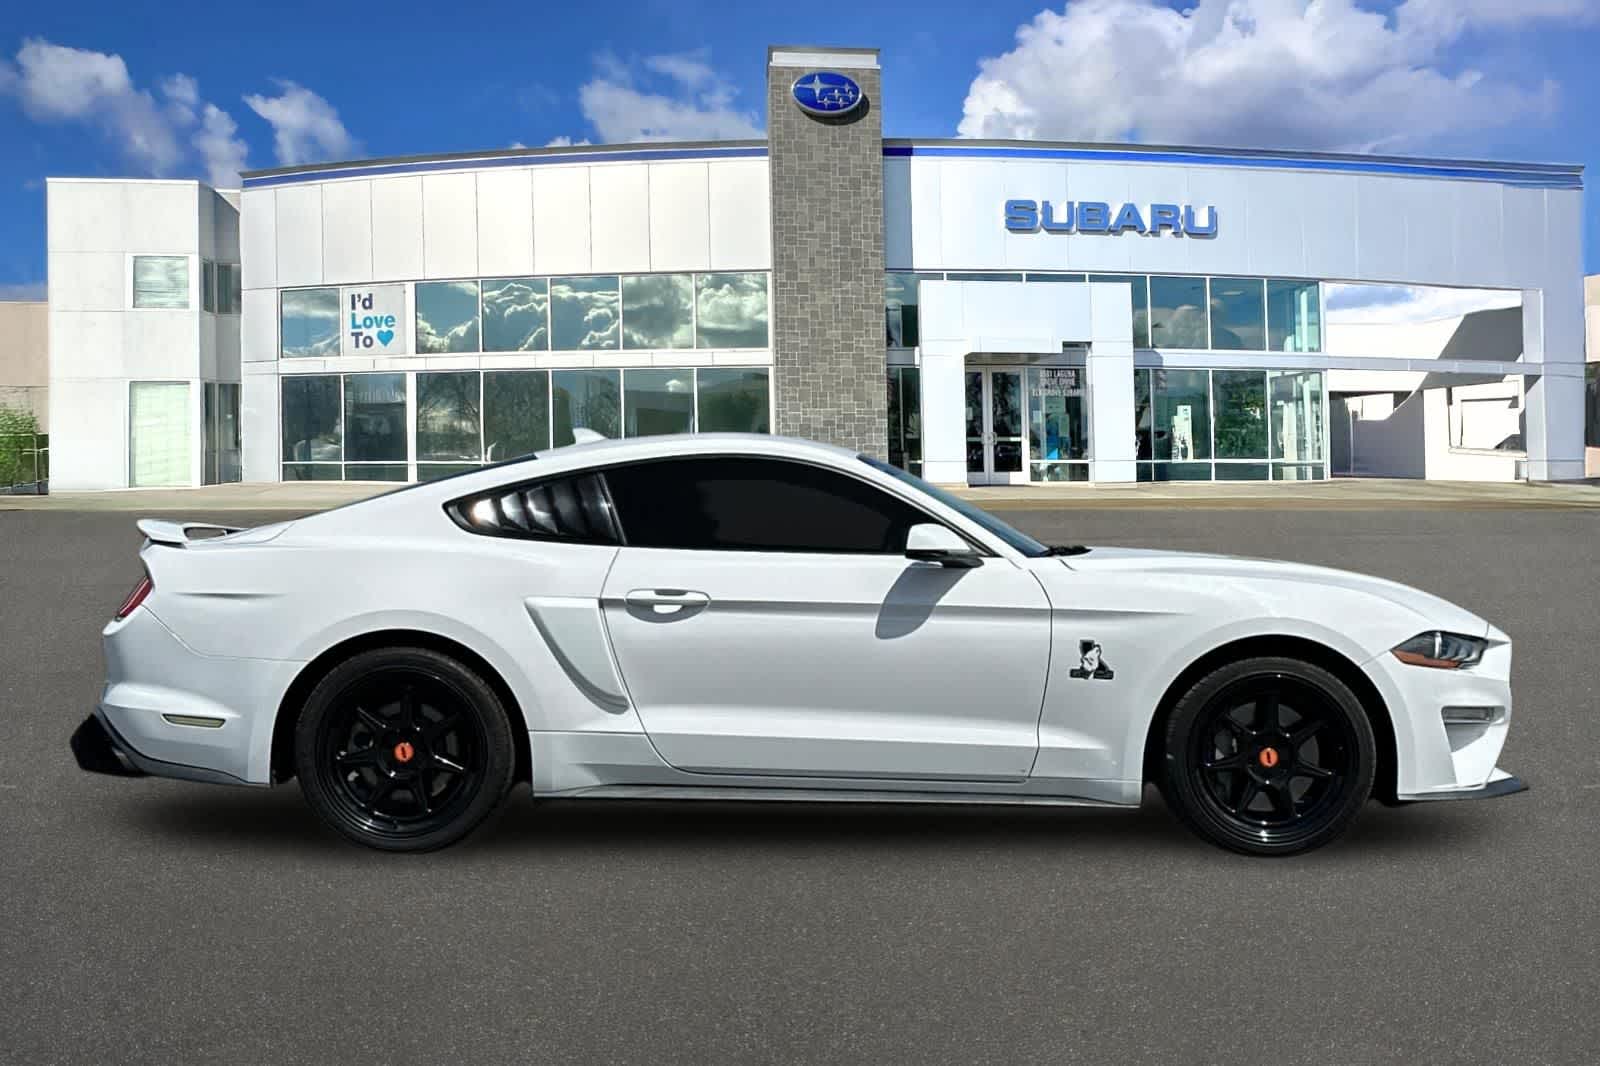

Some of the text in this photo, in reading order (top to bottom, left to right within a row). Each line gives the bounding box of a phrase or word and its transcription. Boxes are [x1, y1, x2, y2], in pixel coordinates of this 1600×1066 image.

[1005, 199, 1218, 239] SUBARU
[351, 293, 373, 310] I'd
[351, 312, 396, 329] Love
[351, 331, 374, 349] To
